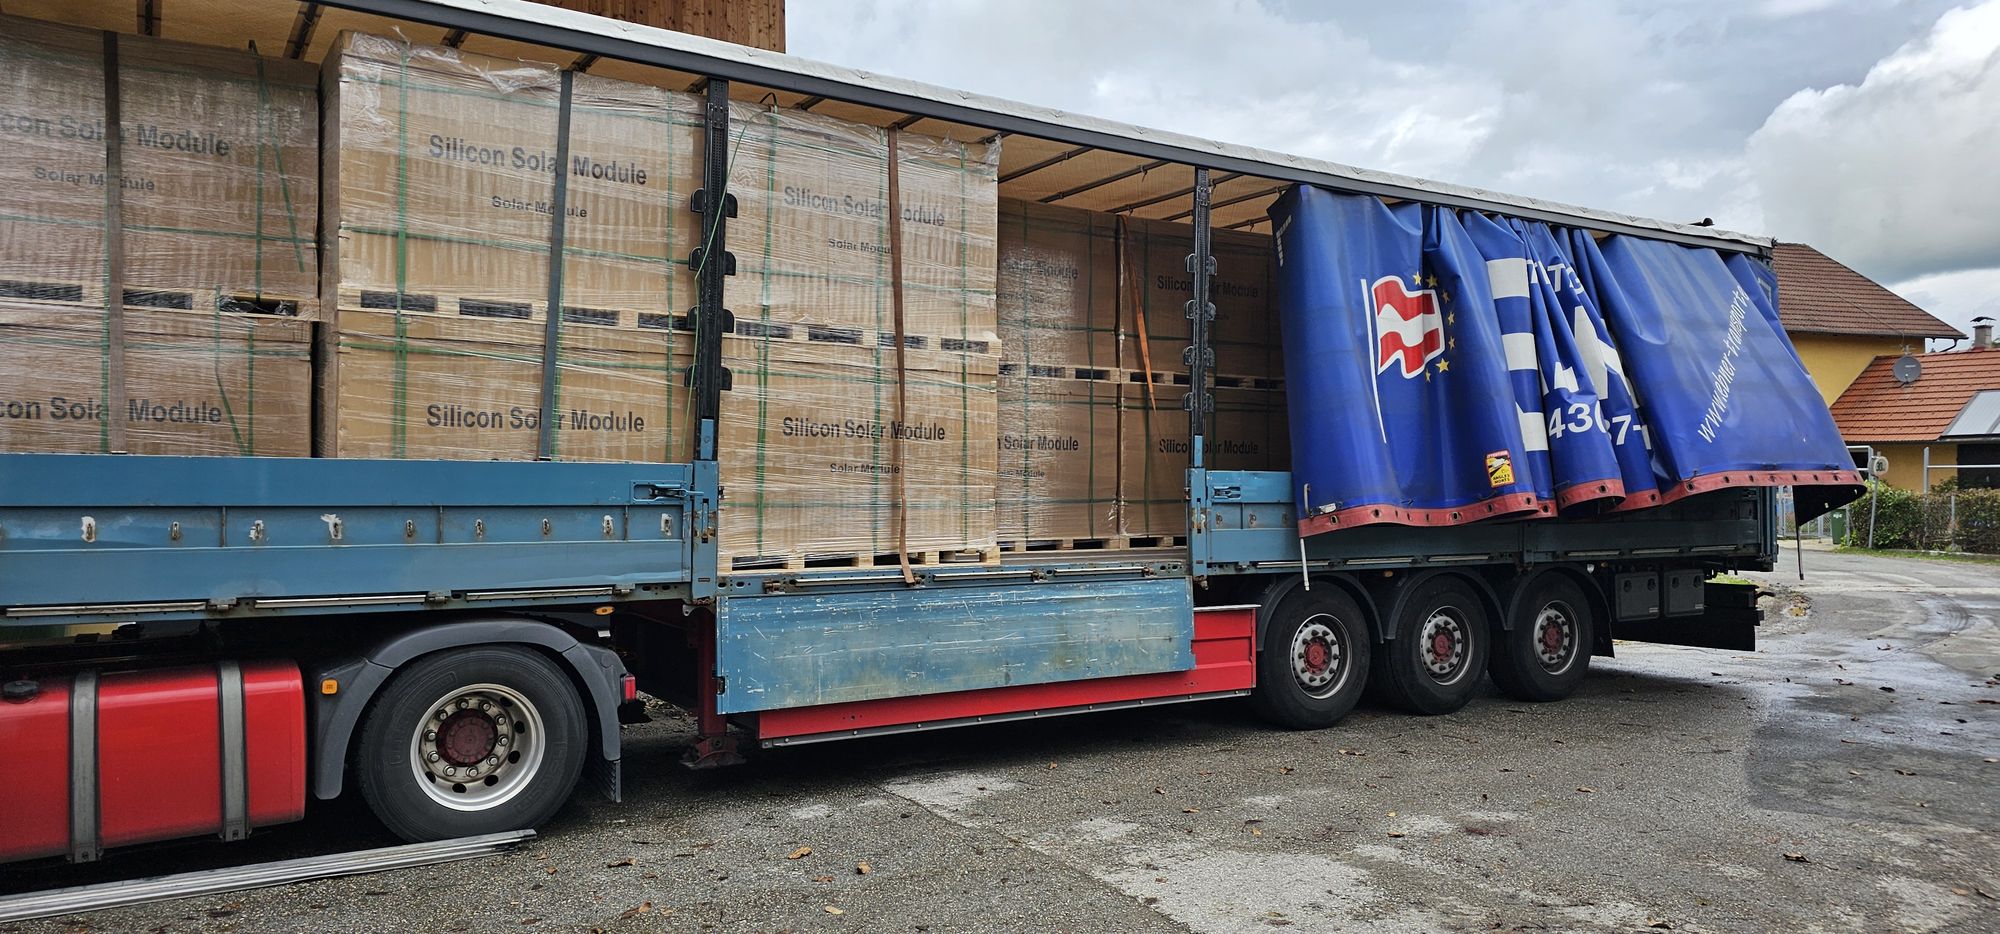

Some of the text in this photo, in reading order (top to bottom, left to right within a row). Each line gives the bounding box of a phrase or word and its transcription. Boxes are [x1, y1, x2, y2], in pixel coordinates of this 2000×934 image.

[60, 114, 129, 144] Solr
[137, 124, 230, 156] Module
[429, 134, 647, 185] Silicon Sola Module
[34, 166, 155, 191] Solar Mdule
[491, 195, 588, 217] Solar Moule
[784, 186, 839, 212] Silicon
[899, 203, 945, 227] odule
[828, 237, 858, 251] Solar
[50, 397, 108, 420] Sola
[128, 399, 222, 423] Module
[427, 404, 645, 432] Silicon Solr Module
[782, 416, 840, 438] Silicon
[890, 421, 945, 440] Module
[1037, 435, 1079, 451] Module
[1159, 438, 1188, 453] Silico
